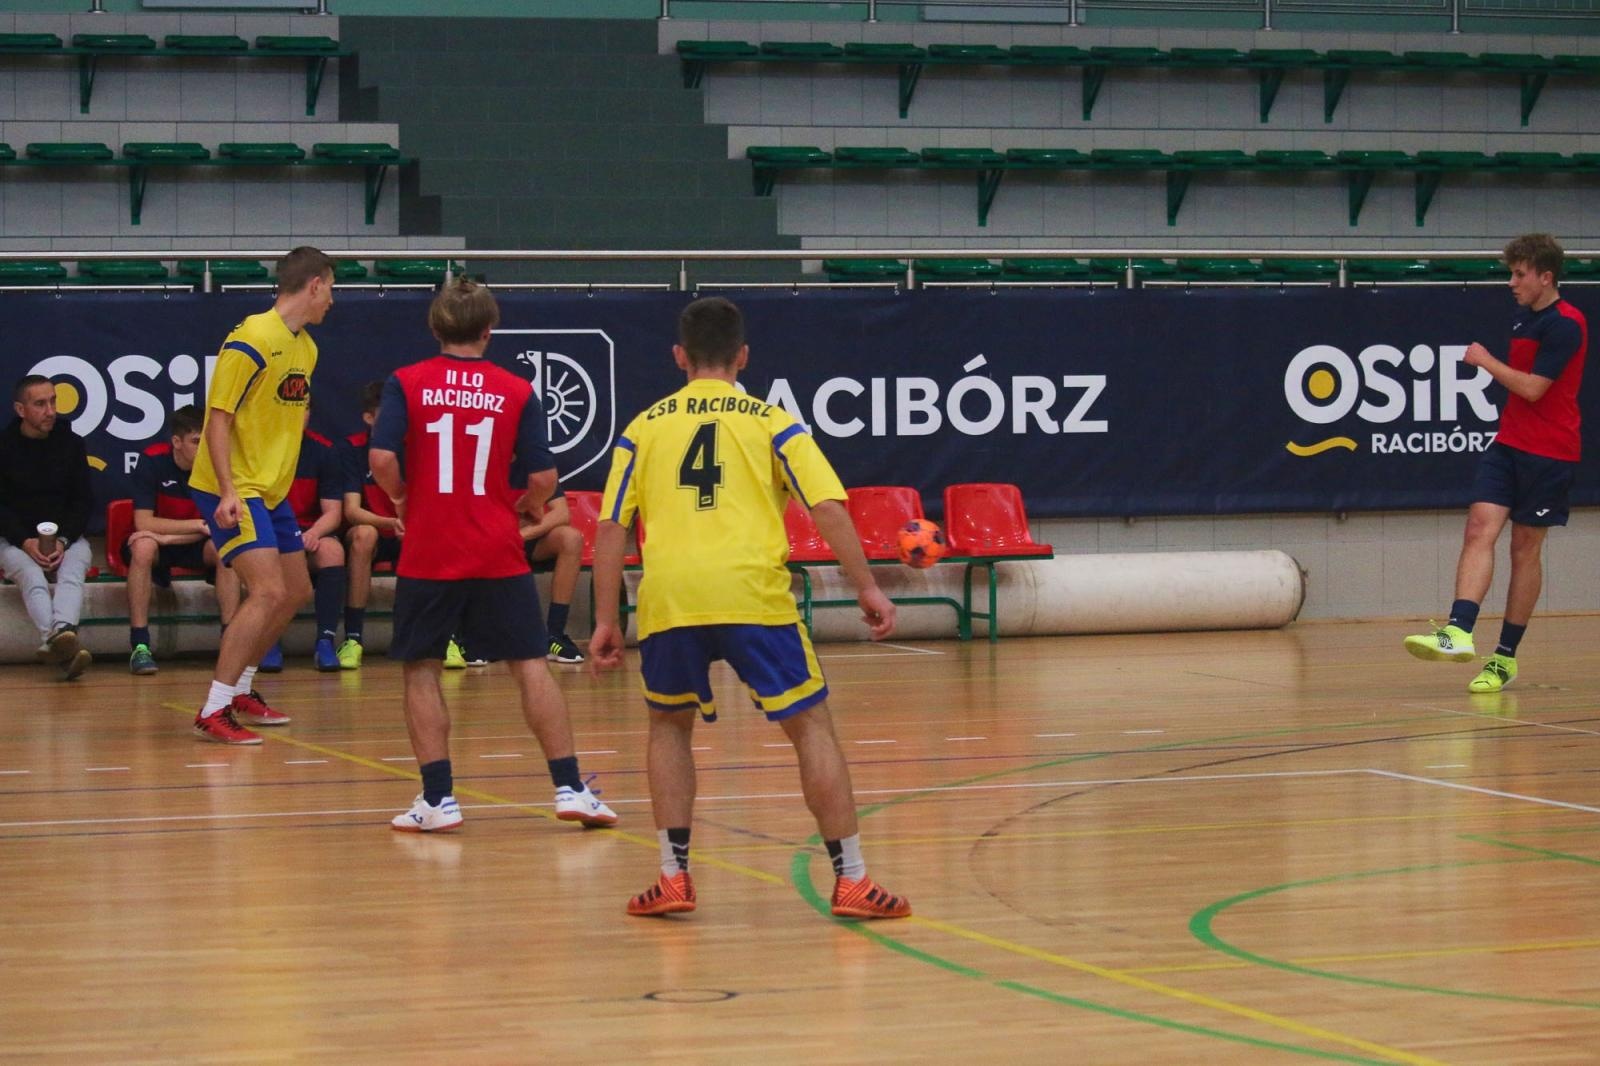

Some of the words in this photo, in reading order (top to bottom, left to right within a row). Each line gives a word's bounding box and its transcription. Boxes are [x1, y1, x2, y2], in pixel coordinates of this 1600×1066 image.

[26, 354, 220, 440] OSi
[422, 388, 505, 413] RACIBÓRZ
[445, 369, 457, 385] II
[462, 371, 484, 388] LO
[735, 353, 1109, 438] ACIBÓRZ
[1284, 344, 1499, 424] OSiR
[425, 412, 496, 496] 11
[676, 418, 725, 512] 4
